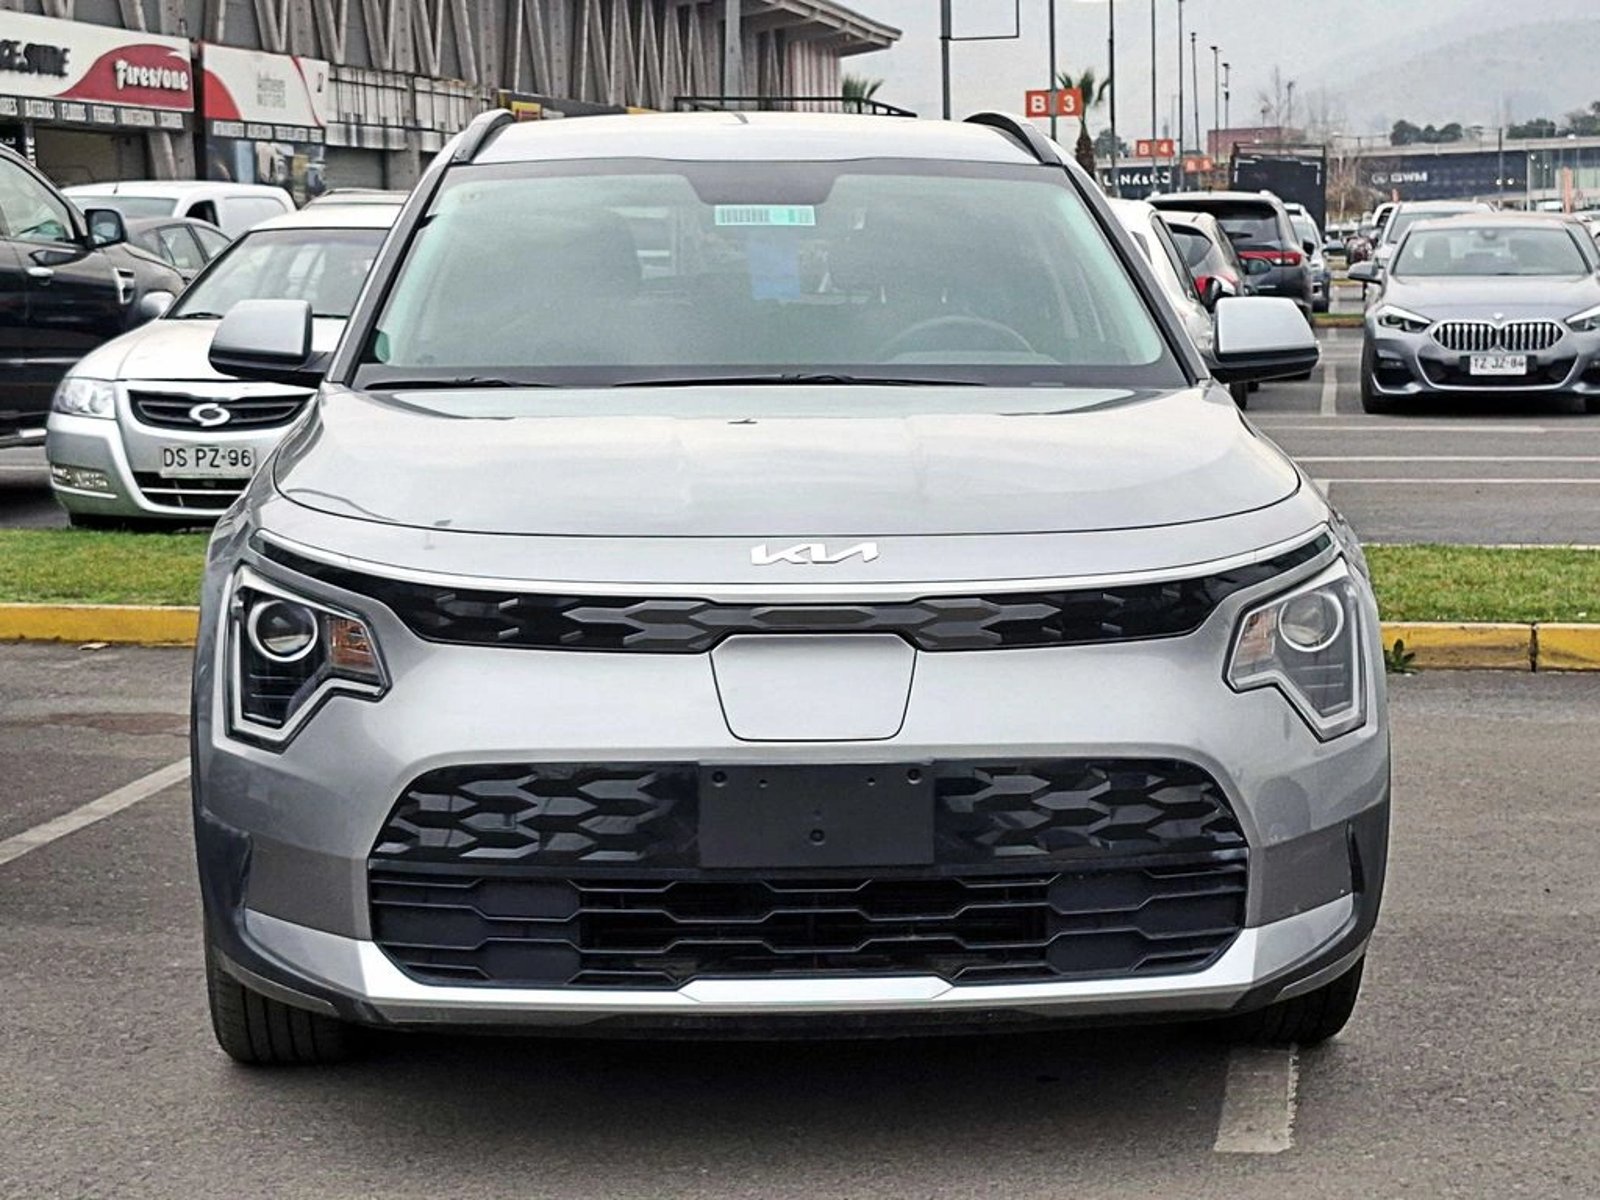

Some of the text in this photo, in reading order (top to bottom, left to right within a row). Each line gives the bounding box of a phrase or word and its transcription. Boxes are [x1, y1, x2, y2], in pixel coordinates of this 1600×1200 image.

[115, 60, 189, 91] Firestone
[1031, 96, 1075, 112] B 3
[1139, 142, 1169, 155] B 4
[1391, 171, 1428, 182] GWM
[163, 448, 188, 468] DS
